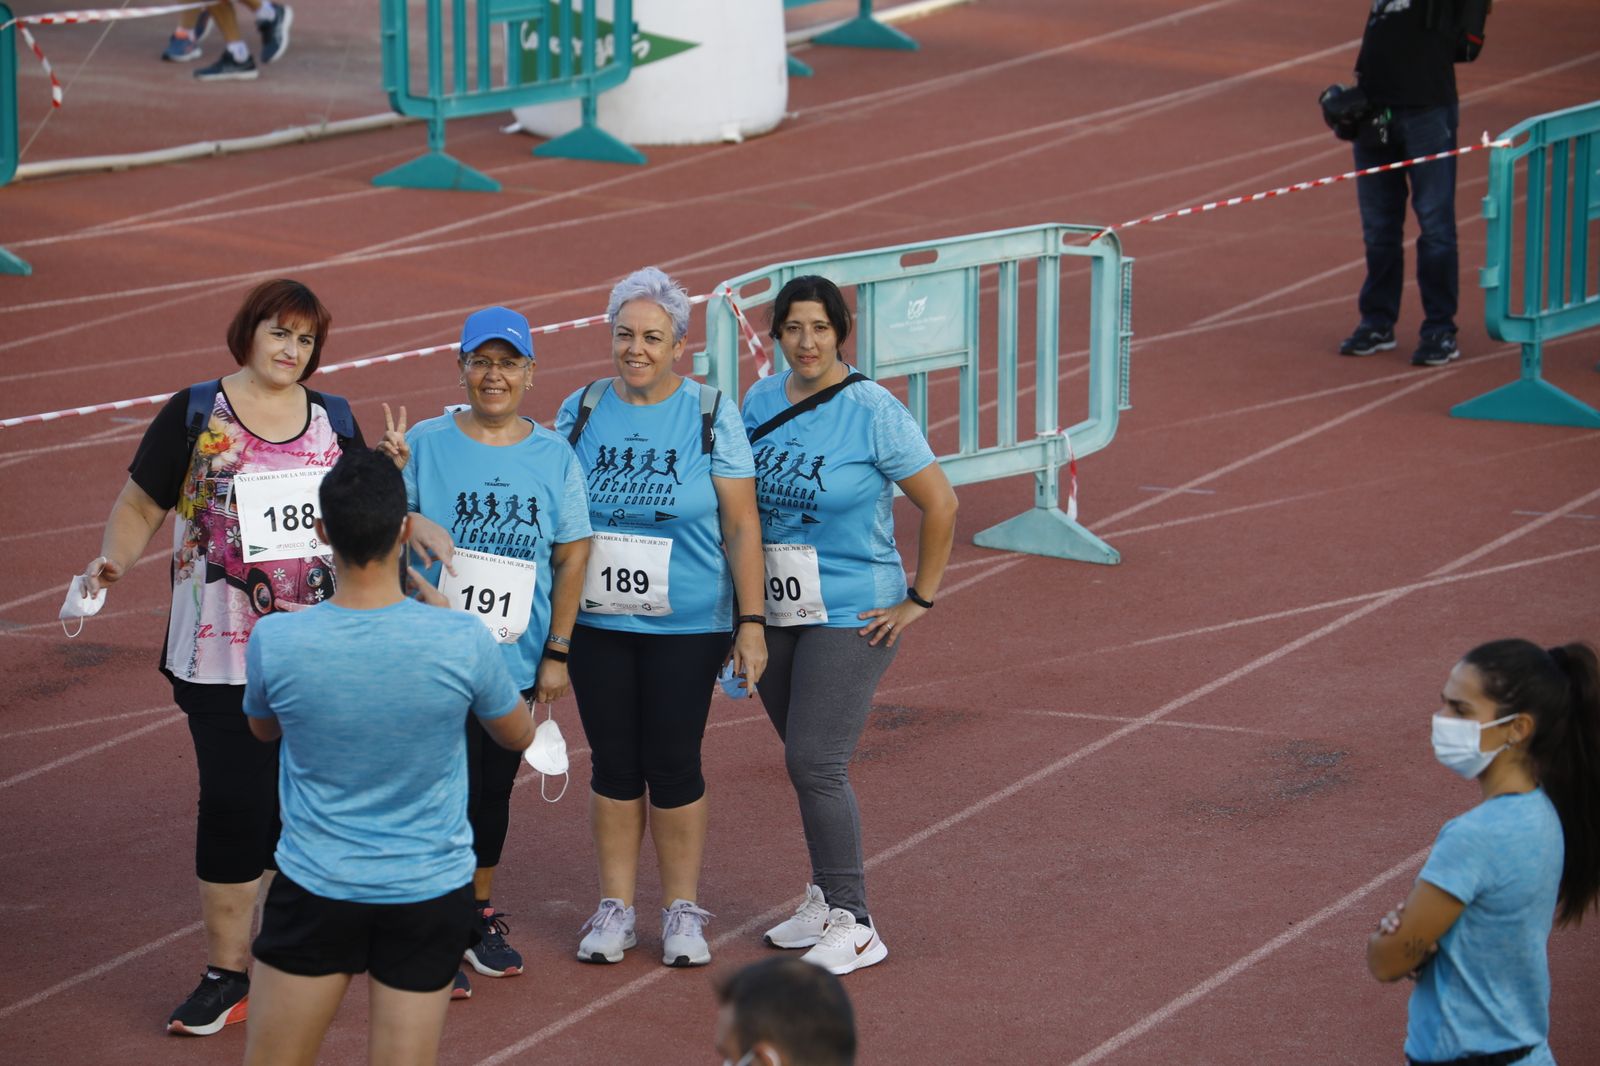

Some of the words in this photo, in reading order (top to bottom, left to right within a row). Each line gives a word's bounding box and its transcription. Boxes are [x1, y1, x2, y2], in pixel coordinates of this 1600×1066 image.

[264, 503, 316, 532] 188
[596, 534, 622, 542] CARRERA
[461, 552, 488, 562] CARRERA
[601, 566, 649, 594] 189
[461, 585, 511, 618] 191
